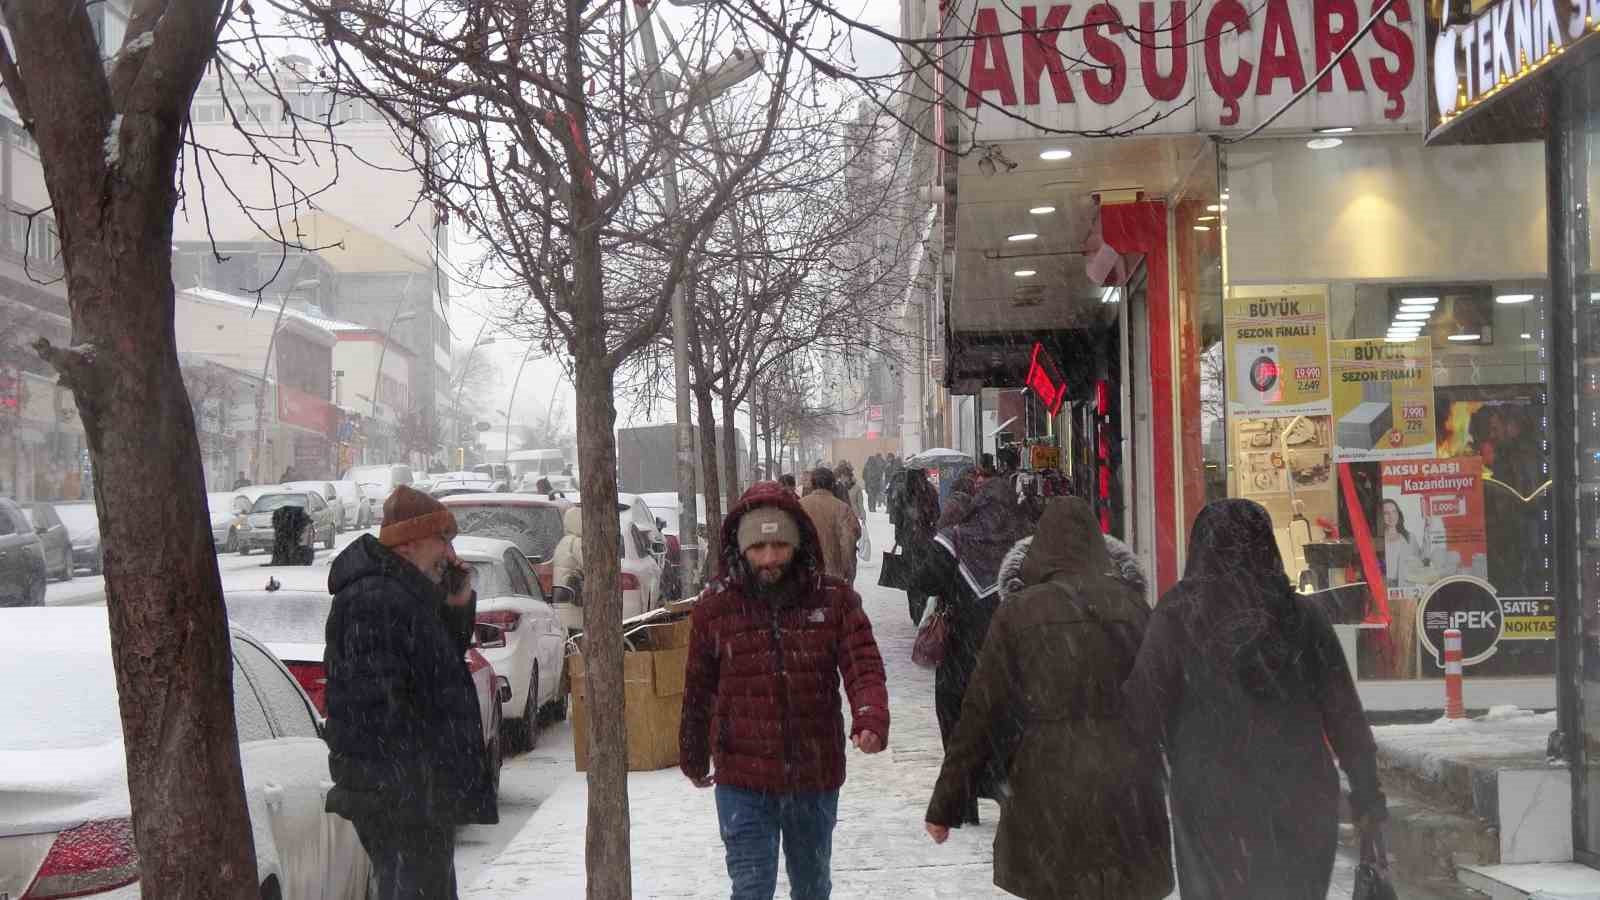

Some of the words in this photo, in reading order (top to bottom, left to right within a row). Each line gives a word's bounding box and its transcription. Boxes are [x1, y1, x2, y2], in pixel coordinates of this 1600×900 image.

[965, 0, 1188, 108] AKSU
[1249, 298, 1299, 317] BÜYÜK
[1237, 327, 1273, 338] SEZON
[1342, 371, 1378, 382] SEZON
[1383, 464, 1418, 476] AKSU
[1503, 601, 1538, 616] SATIŞ
